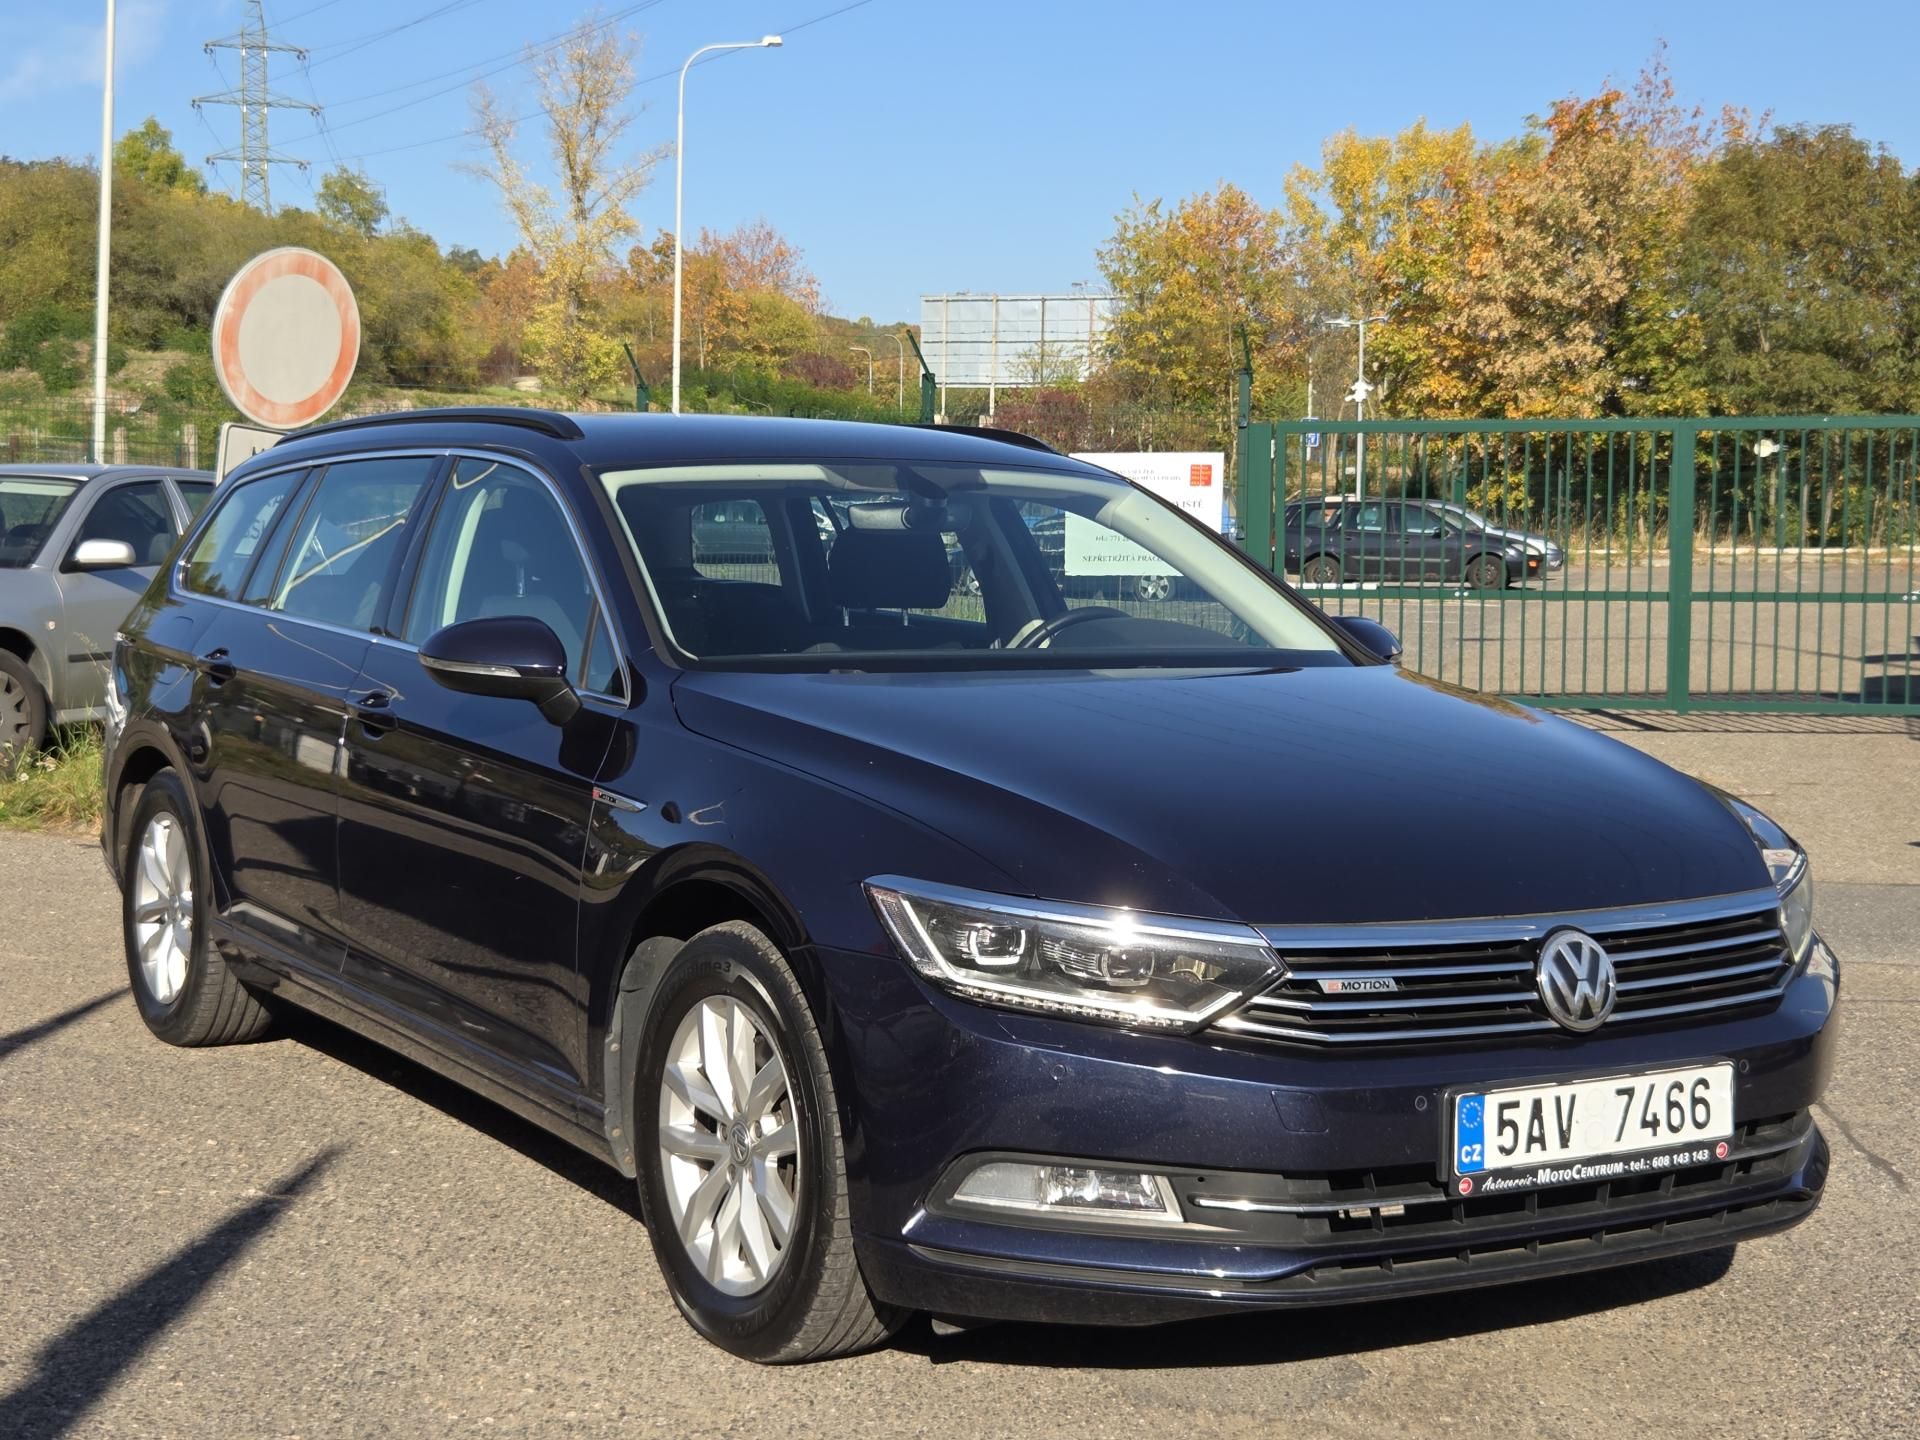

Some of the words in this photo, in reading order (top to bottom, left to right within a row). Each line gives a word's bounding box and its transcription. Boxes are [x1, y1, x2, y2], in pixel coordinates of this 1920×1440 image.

[1496, 1093, 1577, 1156] 5AV
[1614, 1076, 1711, 1142] 7466
[1461, 1143, 1482, 1164] CZ
[1652, 1155, 1670, 1168] 608
[1672, 1152, 1689, 1165] 143
[1692, 1149, 1709, 1161] 143
